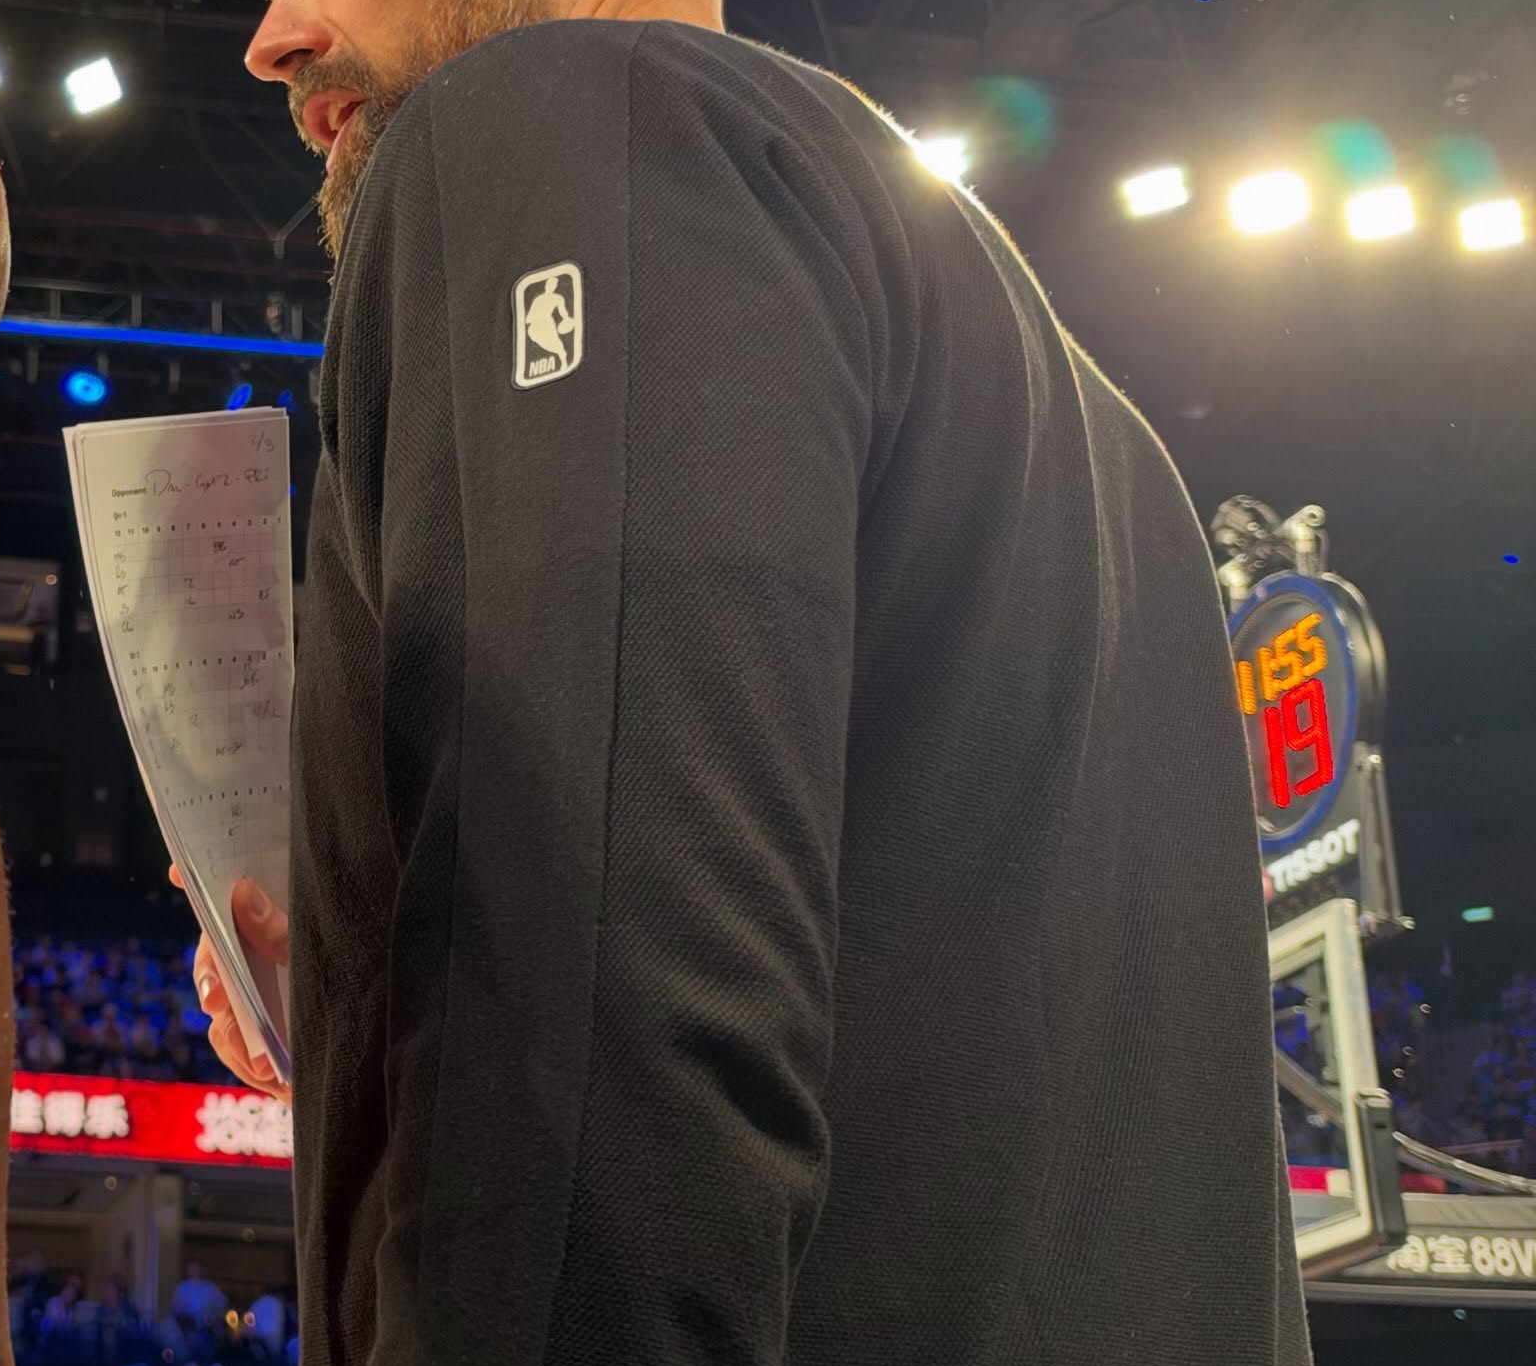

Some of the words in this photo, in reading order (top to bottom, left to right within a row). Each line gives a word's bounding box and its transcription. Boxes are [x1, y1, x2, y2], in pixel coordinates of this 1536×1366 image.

[529, 356, 557, 378] NBA
[1265, 677, 1334, 808] 19
[1268, 818, 1361, 893] TISSOT
[1386, 1235, 1536, 1277] 淘宝88V
